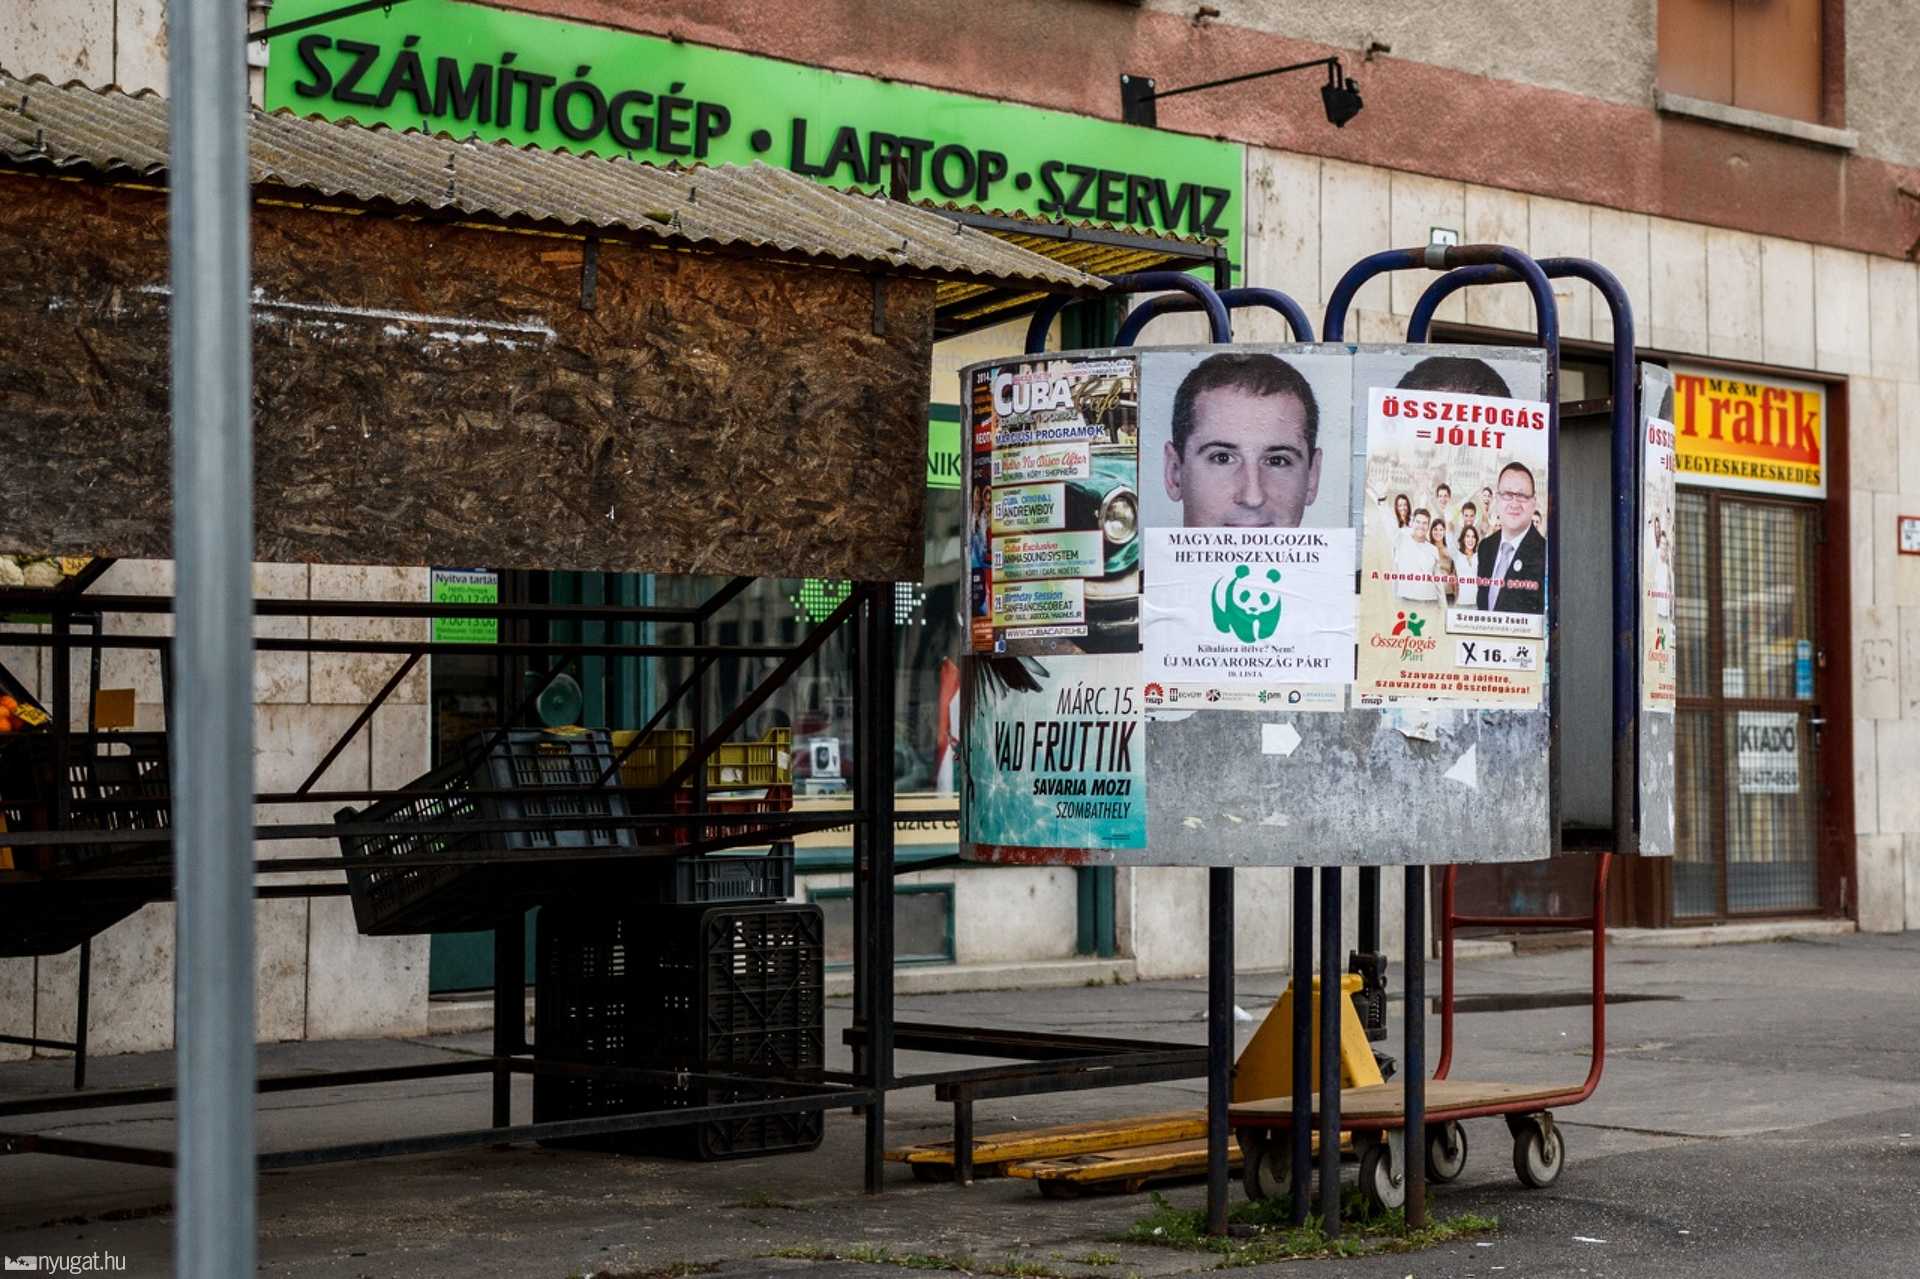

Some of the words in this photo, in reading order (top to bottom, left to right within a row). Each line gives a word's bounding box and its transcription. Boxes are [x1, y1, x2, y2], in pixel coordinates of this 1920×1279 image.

[295, 34, 731, 158] SZÁMÍTÓGÉP
[790, 117, 1008, 202] LAPTOP
[1038, 160, 1232, 238] SZERVIZ
[992, 373, 1075, 417] CUBA
[1710, 379, 1723, 391] M
[1731, 383, 1738, 394] &
[1744, 384, 1757, 396] M
[1382, 396, 1545, 430] ÖSSZEFOGÁS
[1675, 374, 1820, 460] Trafik
[1169, 533, 1238, 548] MAGYAR,
[1242, 533, 1329, 548] DOLGOZIK,
[1175, 548, 1320, 563] HETEROSZEXUÁLIS
[435, 573, 468, 586] Nyitva
[1371, 571, 1379, 580] A
[1163, 655, 1178, 668] ÚJ
[1182, 655, 1293, 668] MAGYARORSZÁG
[1296, 655, 1331, 668] PÁRT
[1483, 649, 1507, 663] 16.
[1740, 720, 1796, 752] KIADÓ
[995, 721, 1025, 772] VAD
[1031, 721, 1138, 772] FRUTTIK
[1033, 778, 1087, 796] SAVARIA
[1090, 778, 1132, 796] MOZI
[1056, 801, 1132, 819] SZOMBATHELY
